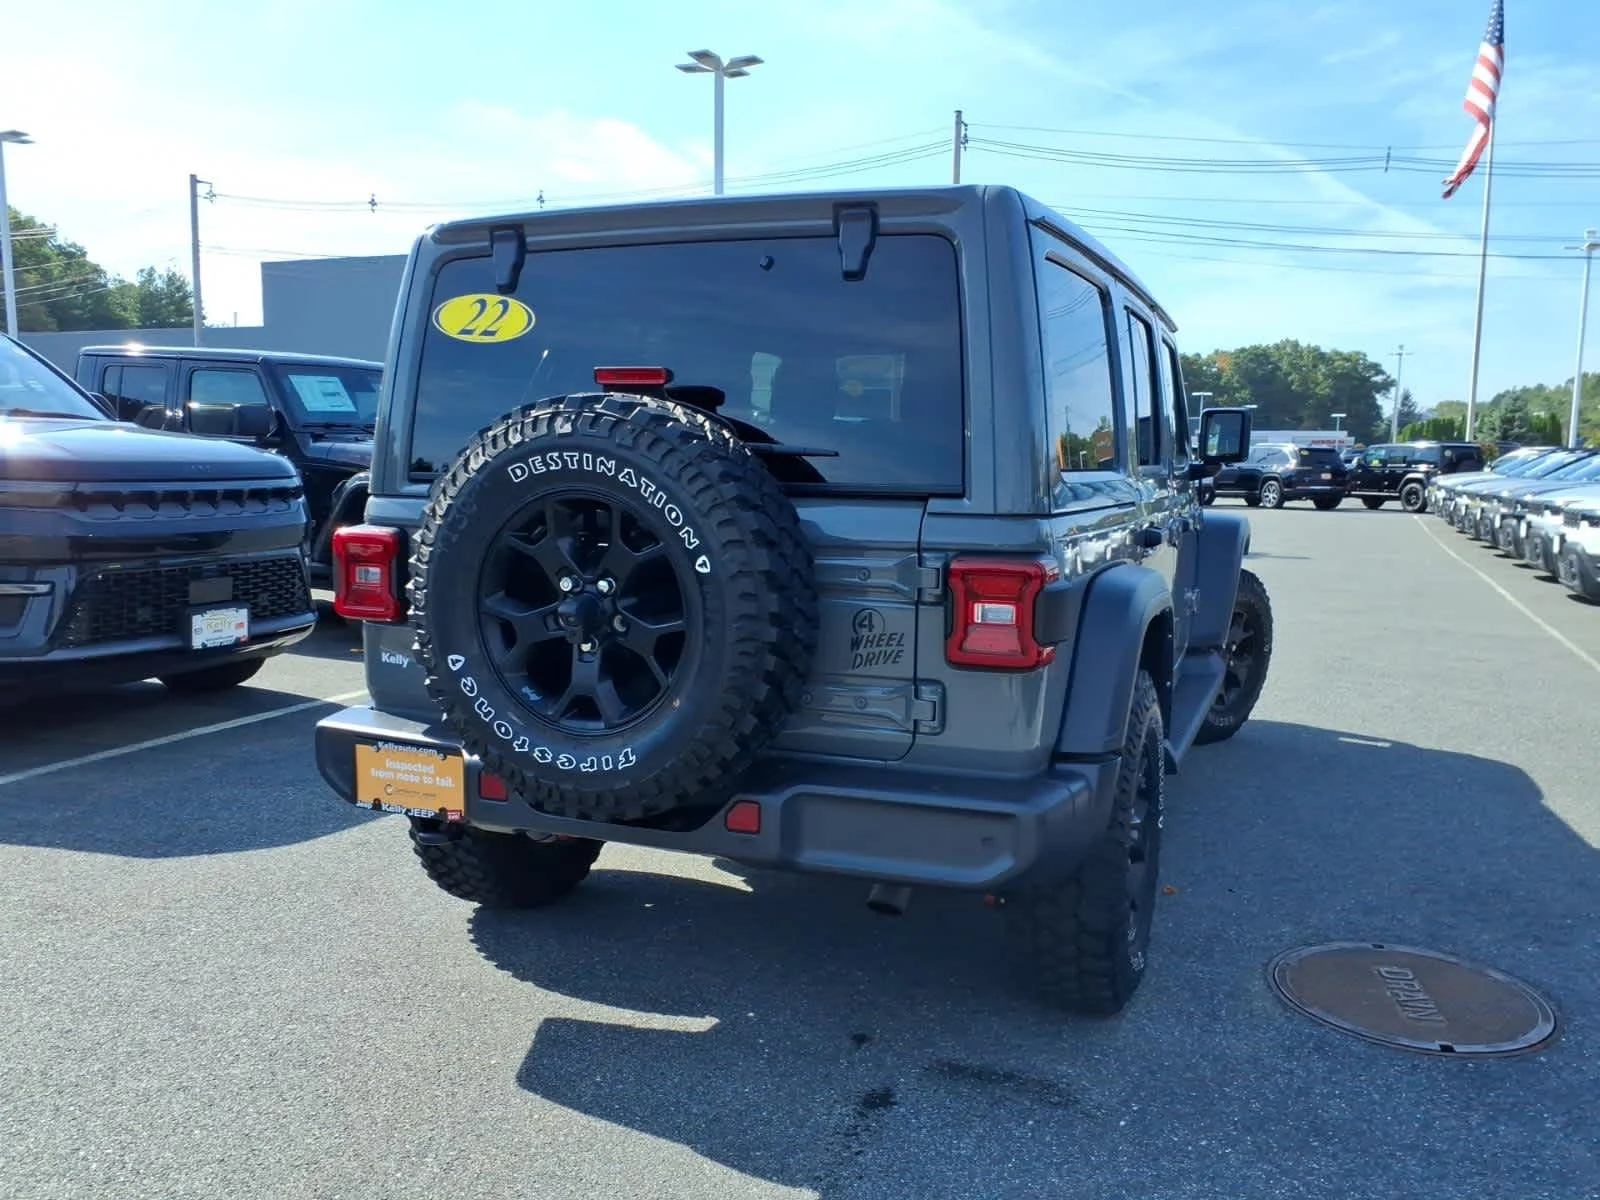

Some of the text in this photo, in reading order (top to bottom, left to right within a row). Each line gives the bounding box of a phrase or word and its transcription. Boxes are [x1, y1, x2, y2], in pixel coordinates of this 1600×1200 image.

[457, 298, 510, 336] 22
[508, 452, 699, 549] DESTINATION
[851, 632, 904, 653] WHEEL
[381, 652, 409, 668] Kelly
[851, 650, 904, 670] DRIVE
[370, 768, 395, 780] from
[396, 772, 420, 784] nose
[423, 774, 433, 784] to
[385, 758, 435, 774] Inspected
[382, 803, 407, 816] Kelly
[408, 808, 435, 819] JEEP
[1377, 966, 1448, 1026] DRAIN
